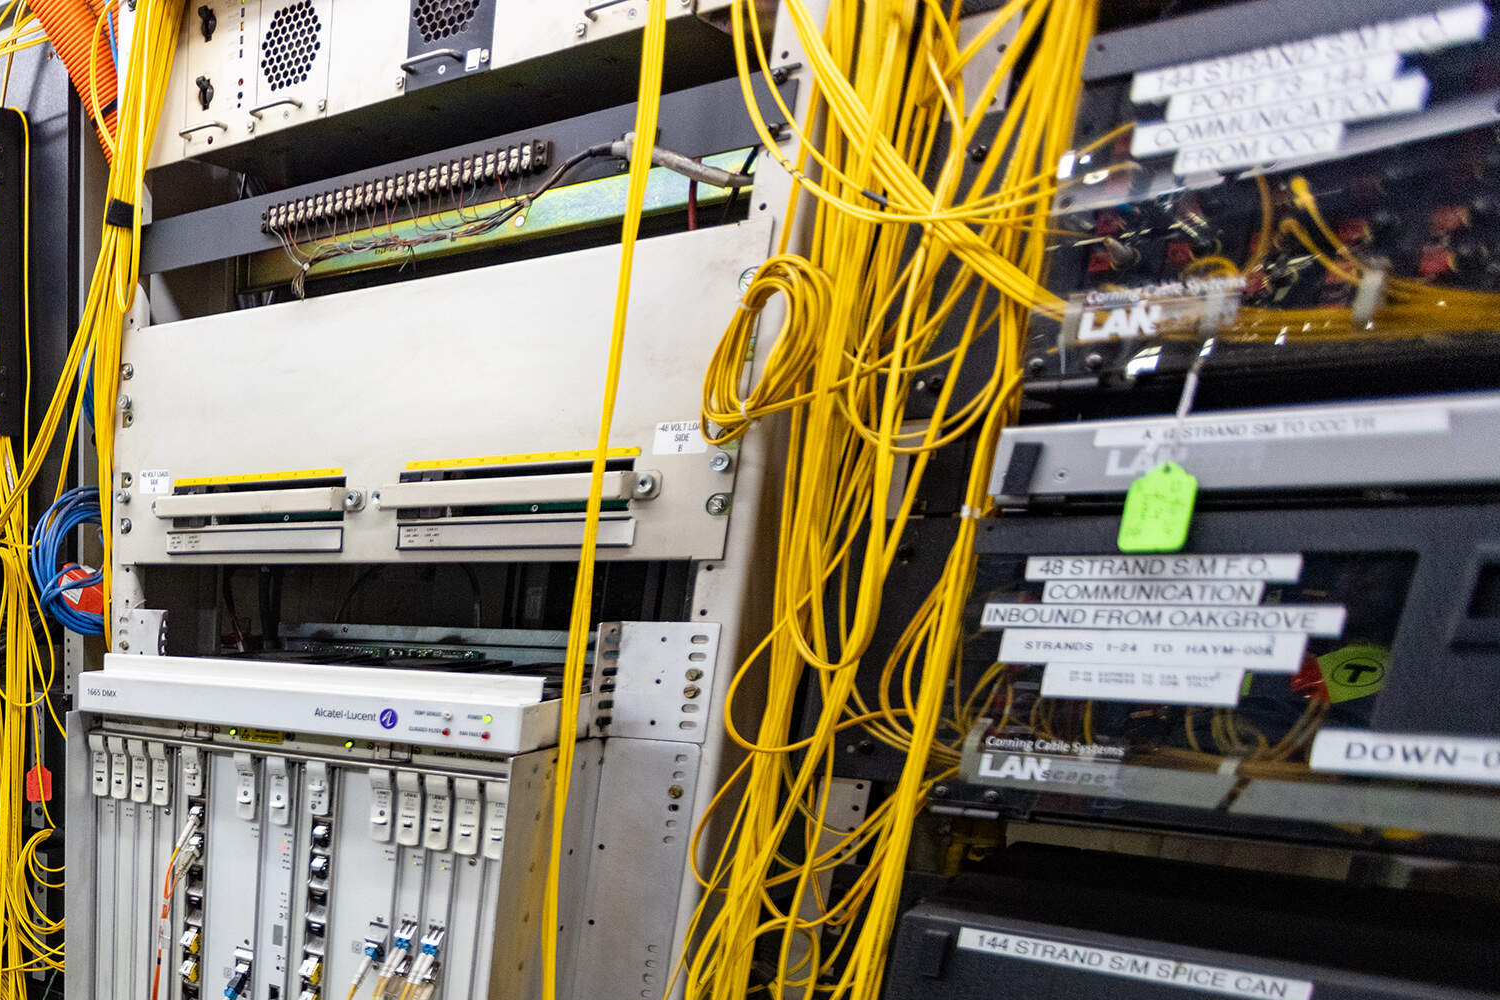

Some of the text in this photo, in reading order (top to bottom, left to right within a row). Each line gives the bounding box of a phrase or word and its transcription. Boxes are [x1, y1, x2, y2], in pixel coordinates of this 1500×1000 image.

[1153, 87, 1394, 149] COMMUNICATION
[671, 423, 687, 431] VOLT
[674, 433, 690, 442] SIDE
[1038, 558, 1064, 576] 48
[1069, 558, 1166, 577] STRAND
[1047, 583, 1257, 602] COMMUNICATION
[986, 607, 1318, 630] INBOUND FROM OAKGROVE
[1023, 640, 1094, 652] STRANDS
[1152, 643, 1173, 653] TO
[87, 688, 117, 697] 1665 DMX
[314, 707, 377, 722] Alcatel-Lucent
[985, 735, 1125, 758] Corning Cable Systems
[976, 934, 1289, 998] 144 STRAND S/M SPICE CAN
